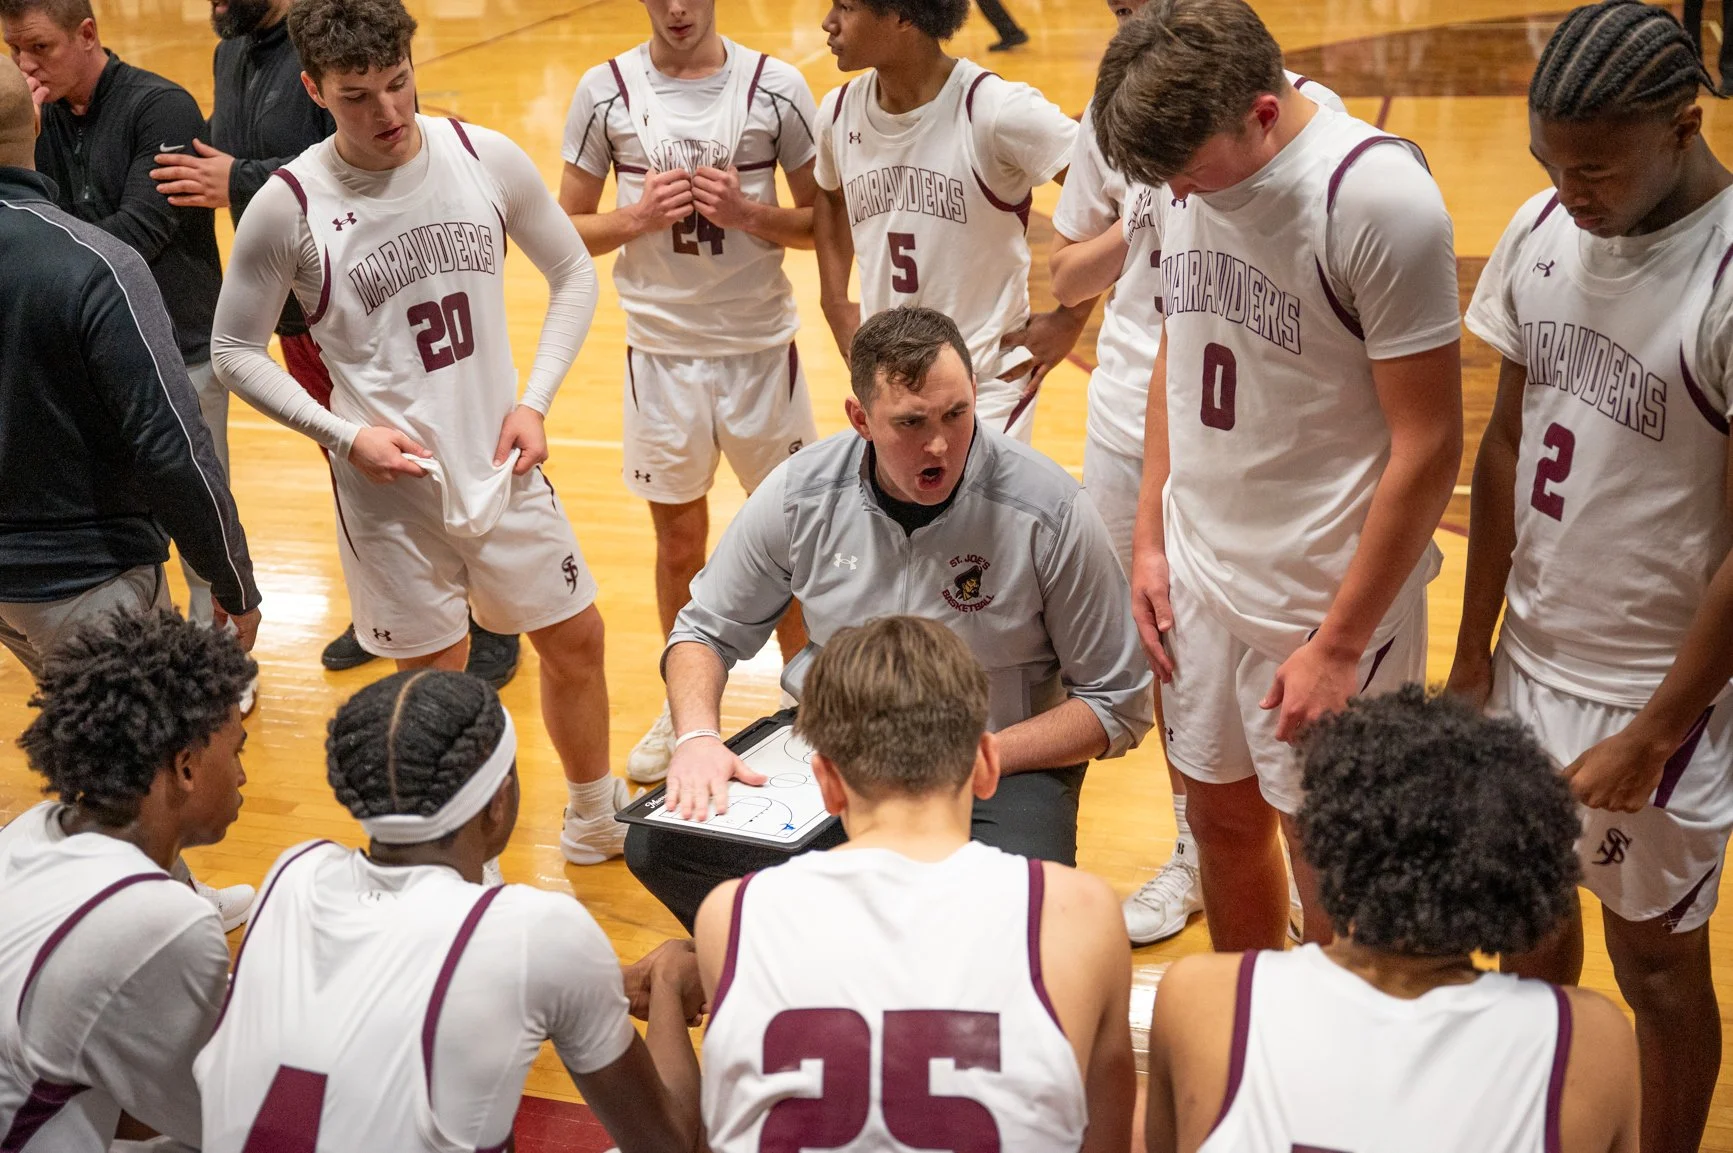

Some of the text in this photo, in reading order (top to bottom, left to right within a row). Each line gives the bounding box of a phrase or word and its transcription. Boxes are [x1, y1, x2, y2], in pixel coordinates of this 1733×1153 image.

[671, 206, 725, 256] 24
[847, 165, 967, 227] MARAUDERS
[349, 222, 496, 316] MARAUDERS
[887, 232, 919, 293] 5
[1161, 250, 1302, 355] MARAUDERS
[407, 291, 475, 373] 20
[1200, 342, 1237, 431] 0
[1530, 422, 1576, 522] 2
[942, 588, 995, 612] BASKETBALL
[949, 554, 991, 571] ST. JOE'S
[758, 1007, 1002, 1153] 25
